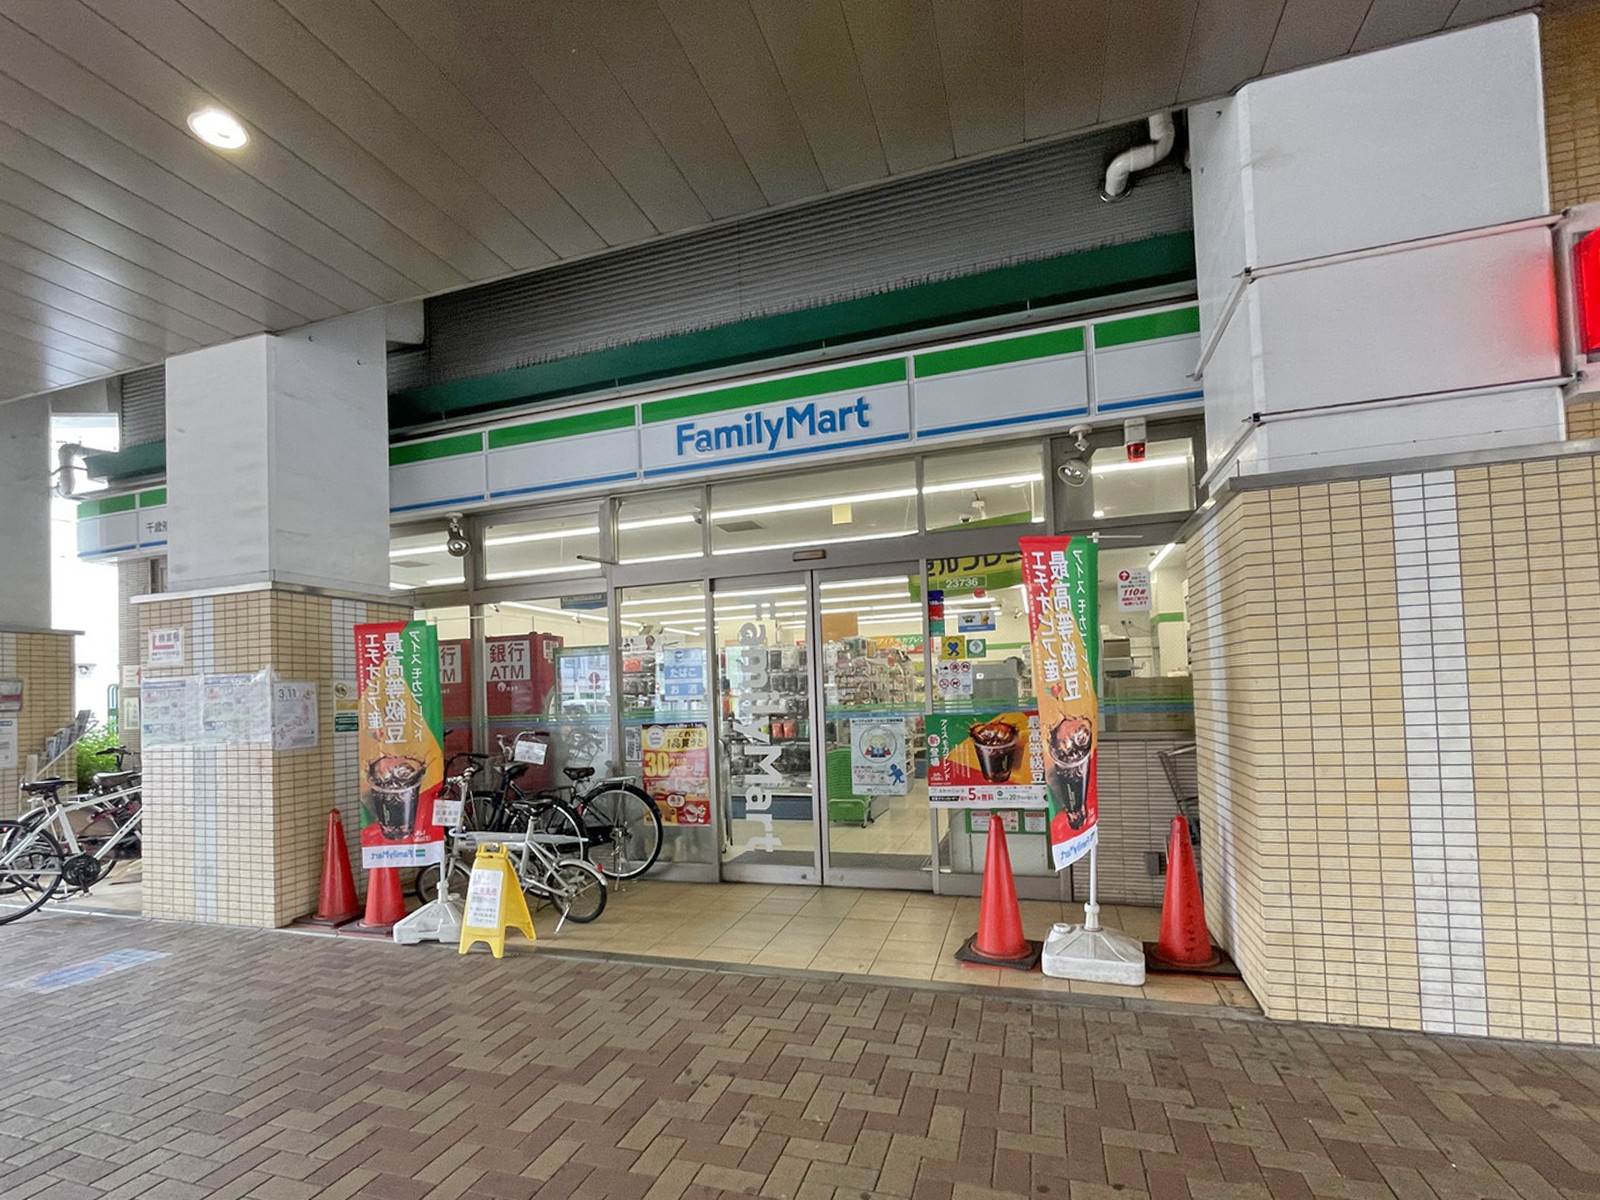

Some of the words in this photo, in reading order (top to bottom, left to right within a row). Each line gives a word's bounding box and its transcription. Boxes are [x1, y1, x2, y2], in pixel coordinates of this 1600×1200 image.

[676, 396, 870, 456] FamilyMart
[946, 577, 978, 588] 23736
[489, 643, 525, 663] 銀行
[490, 665, 524, 680] ATM
[670, 668, 696, 677] たばこ
[667, 737, 703, 749] 1品買うと
